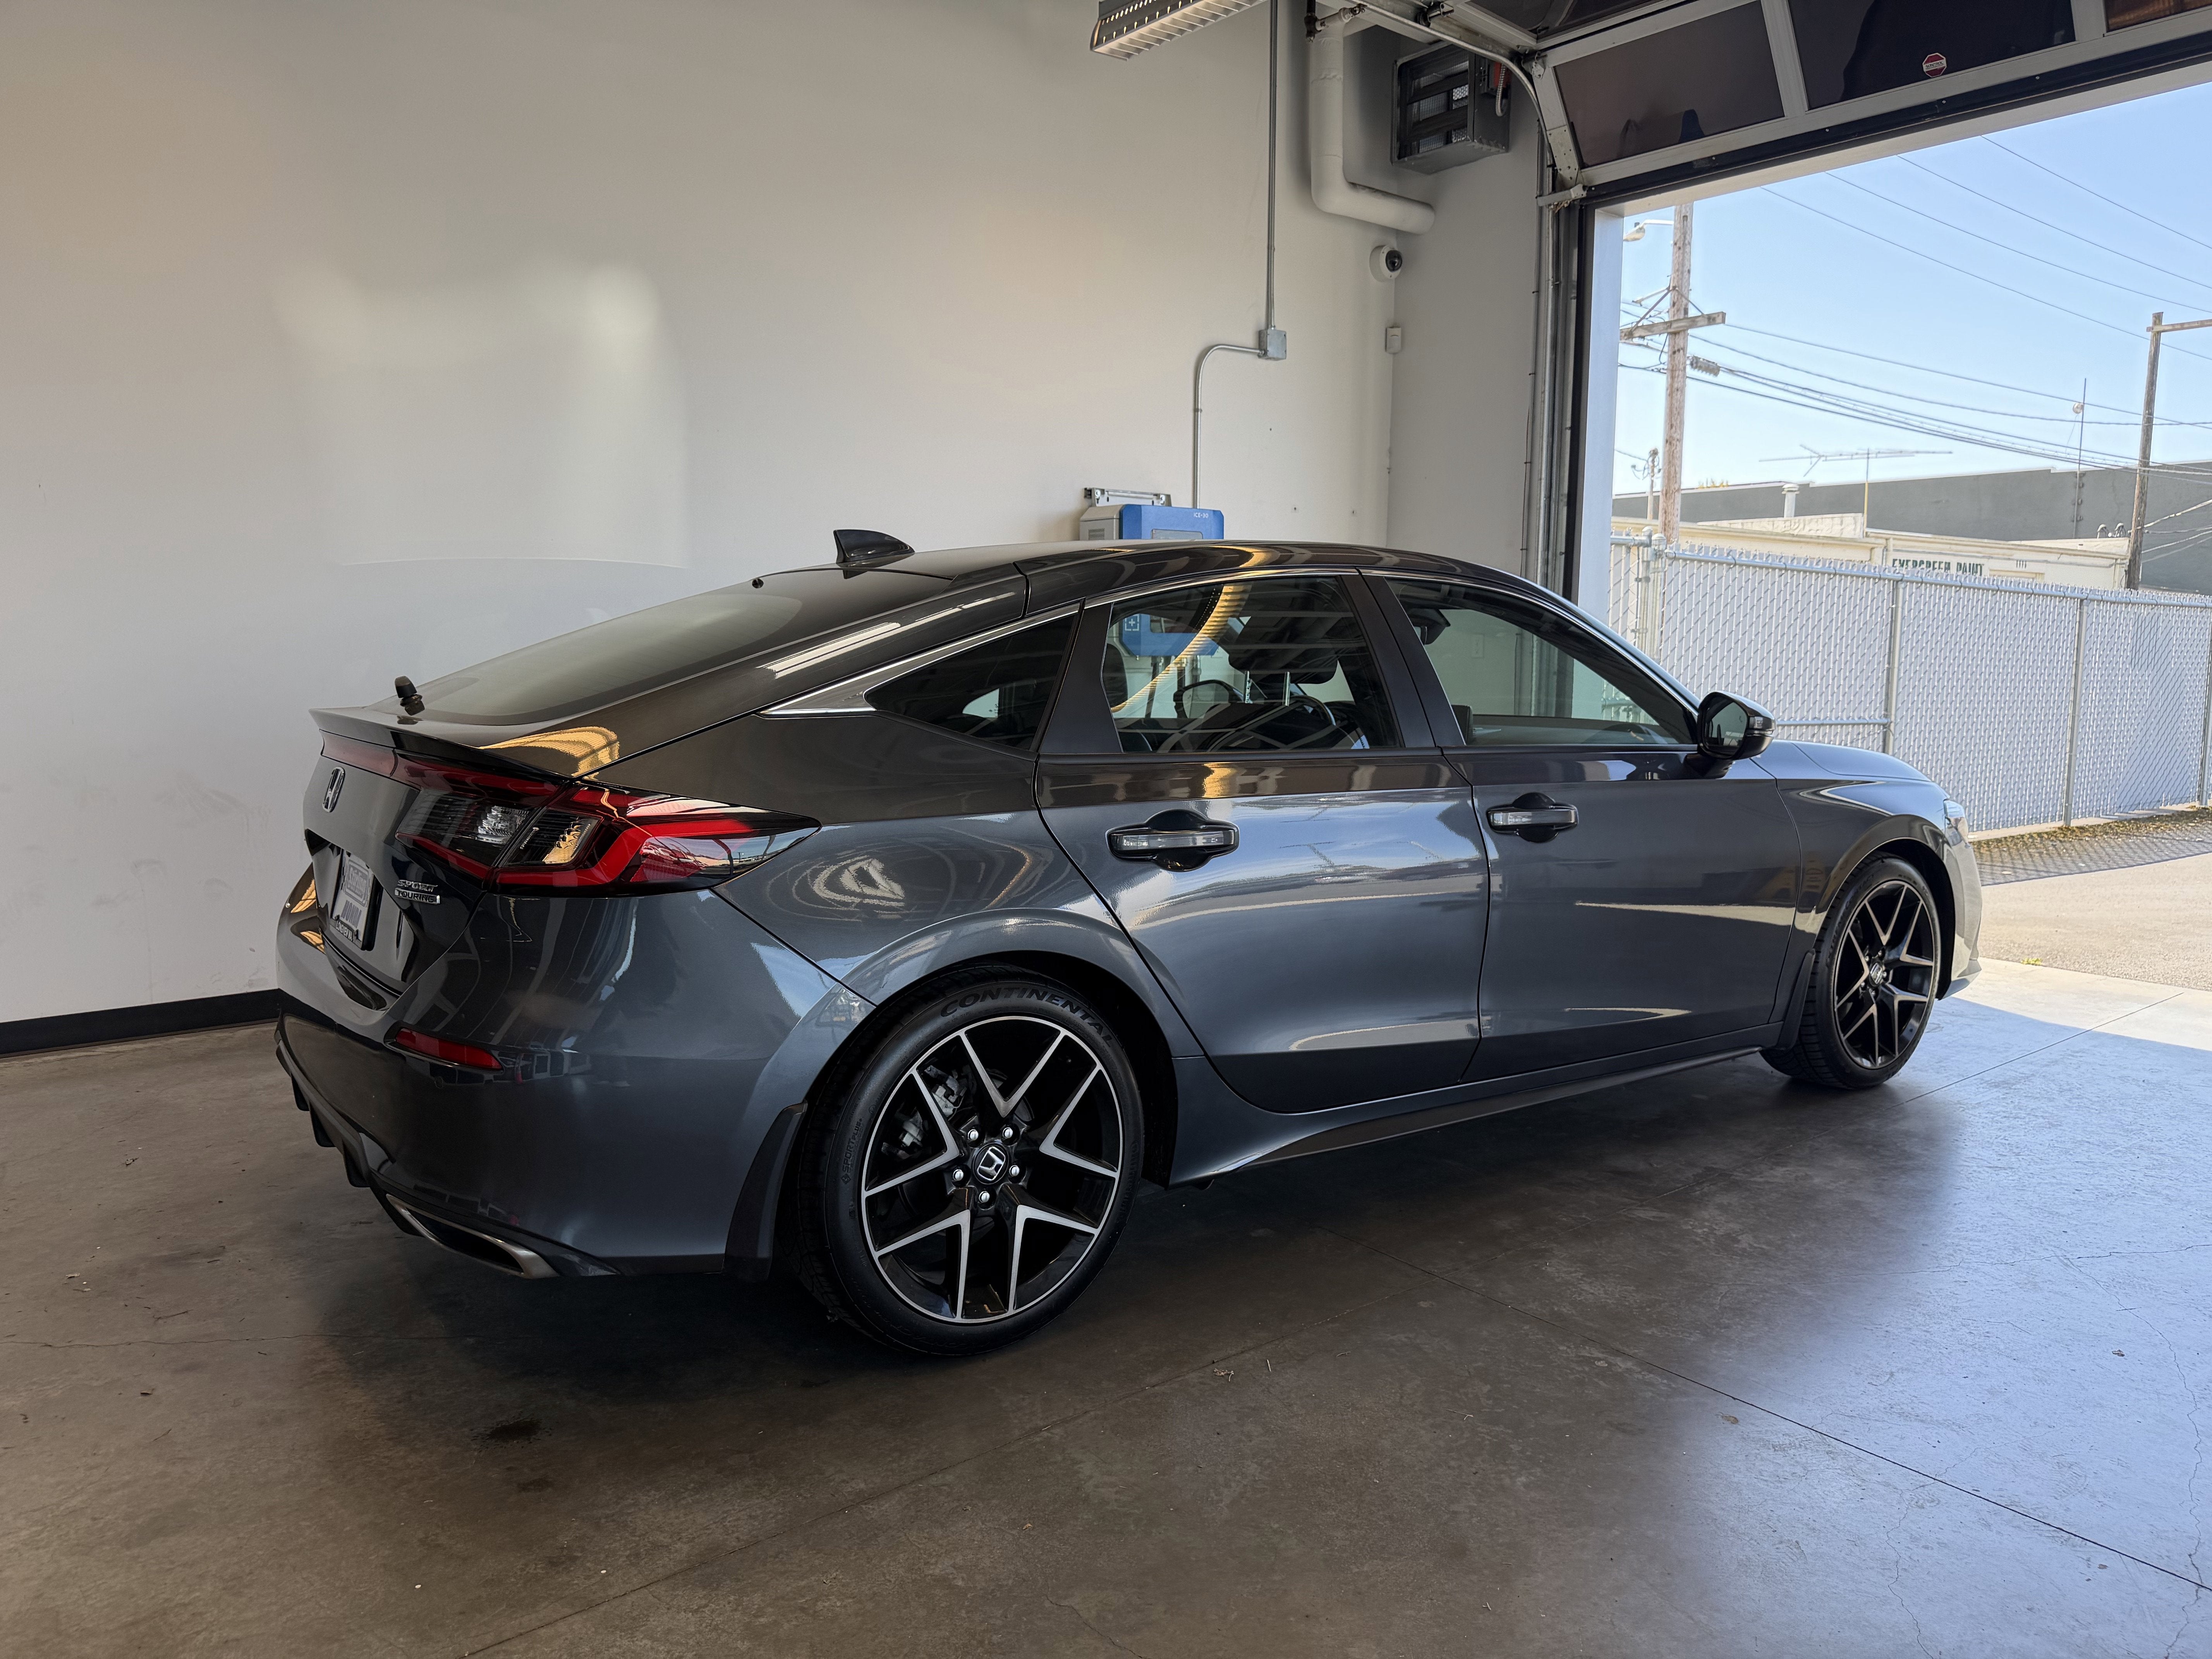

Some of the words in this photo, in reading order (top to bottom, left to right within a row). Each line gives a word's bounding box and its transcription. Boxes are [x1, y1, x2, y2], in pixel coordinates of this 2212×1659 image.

[397, 879, 438, 892] SPORT
[398, 890, 434, 903] TOURING
[940, 987, 1115, 1047] CONTINENTAL
